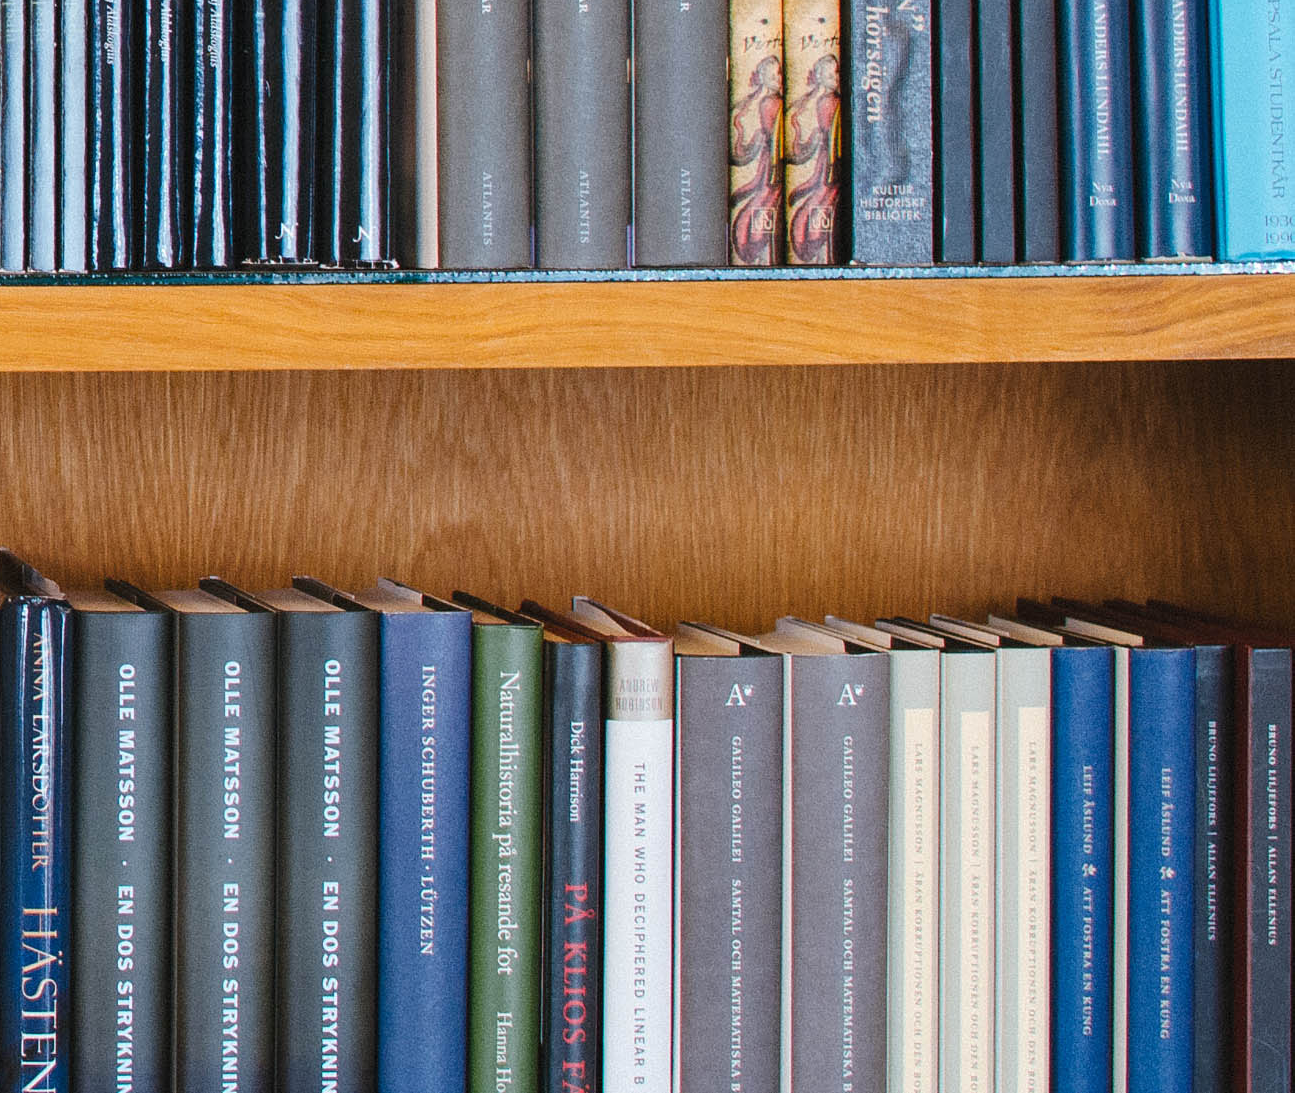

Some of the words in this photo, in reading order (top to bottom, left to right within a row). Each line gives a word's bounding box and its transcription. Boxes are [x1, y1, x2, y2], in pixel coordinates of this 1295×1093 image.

[864, 6, 887, 122] hörsägen
[1093, 1, 1107, 69] ANDERS
[1095, 75, 1109, 160] LUNDAHL
[680, 168, 691, 242] ATLANTIS
[324, 660, 340, 716] OLLE
[421, 665, 436, 730] INGER
[497, 671, 521, 828] Naturalhistoria
[569, 721, 584, 754] Dick
[731, 736, 742, 799] GALILEO
[323, 726, 339, 837] MATSSON
[421, 736, 435, 860] SCHUBERTH
[568, 759, 584, 822] Harrison
[634, 763, 646, 794] THE
[1161, 768, 1172, 797] LEIF
[493, 833, 515, 859] på
[634, 803, 646, 837] MAN
[731, 804, 742, 862] GALILEI
[1161, 802, 1174, 856] ÅSLUND
[323, 881, 338, 910] EN
[634, 847, 646, 884] WHO
[420, 876, 438, 955] LÜTZEN
[497, 863, 512, 941] resande
[564, 882, 595, 924] PÅ
[322, 921, 338, 968] DOS
[496, 946, 518, 974] fot
[634, 894, 646, 998] DECIPHERED
[21, 907, 64, 1093] HÄSTEN
[562, 941, 587, 1045] KLIOS
[634, 1008, 645, 1069] LINEAR
[634, 1077, 645, 1085] B
